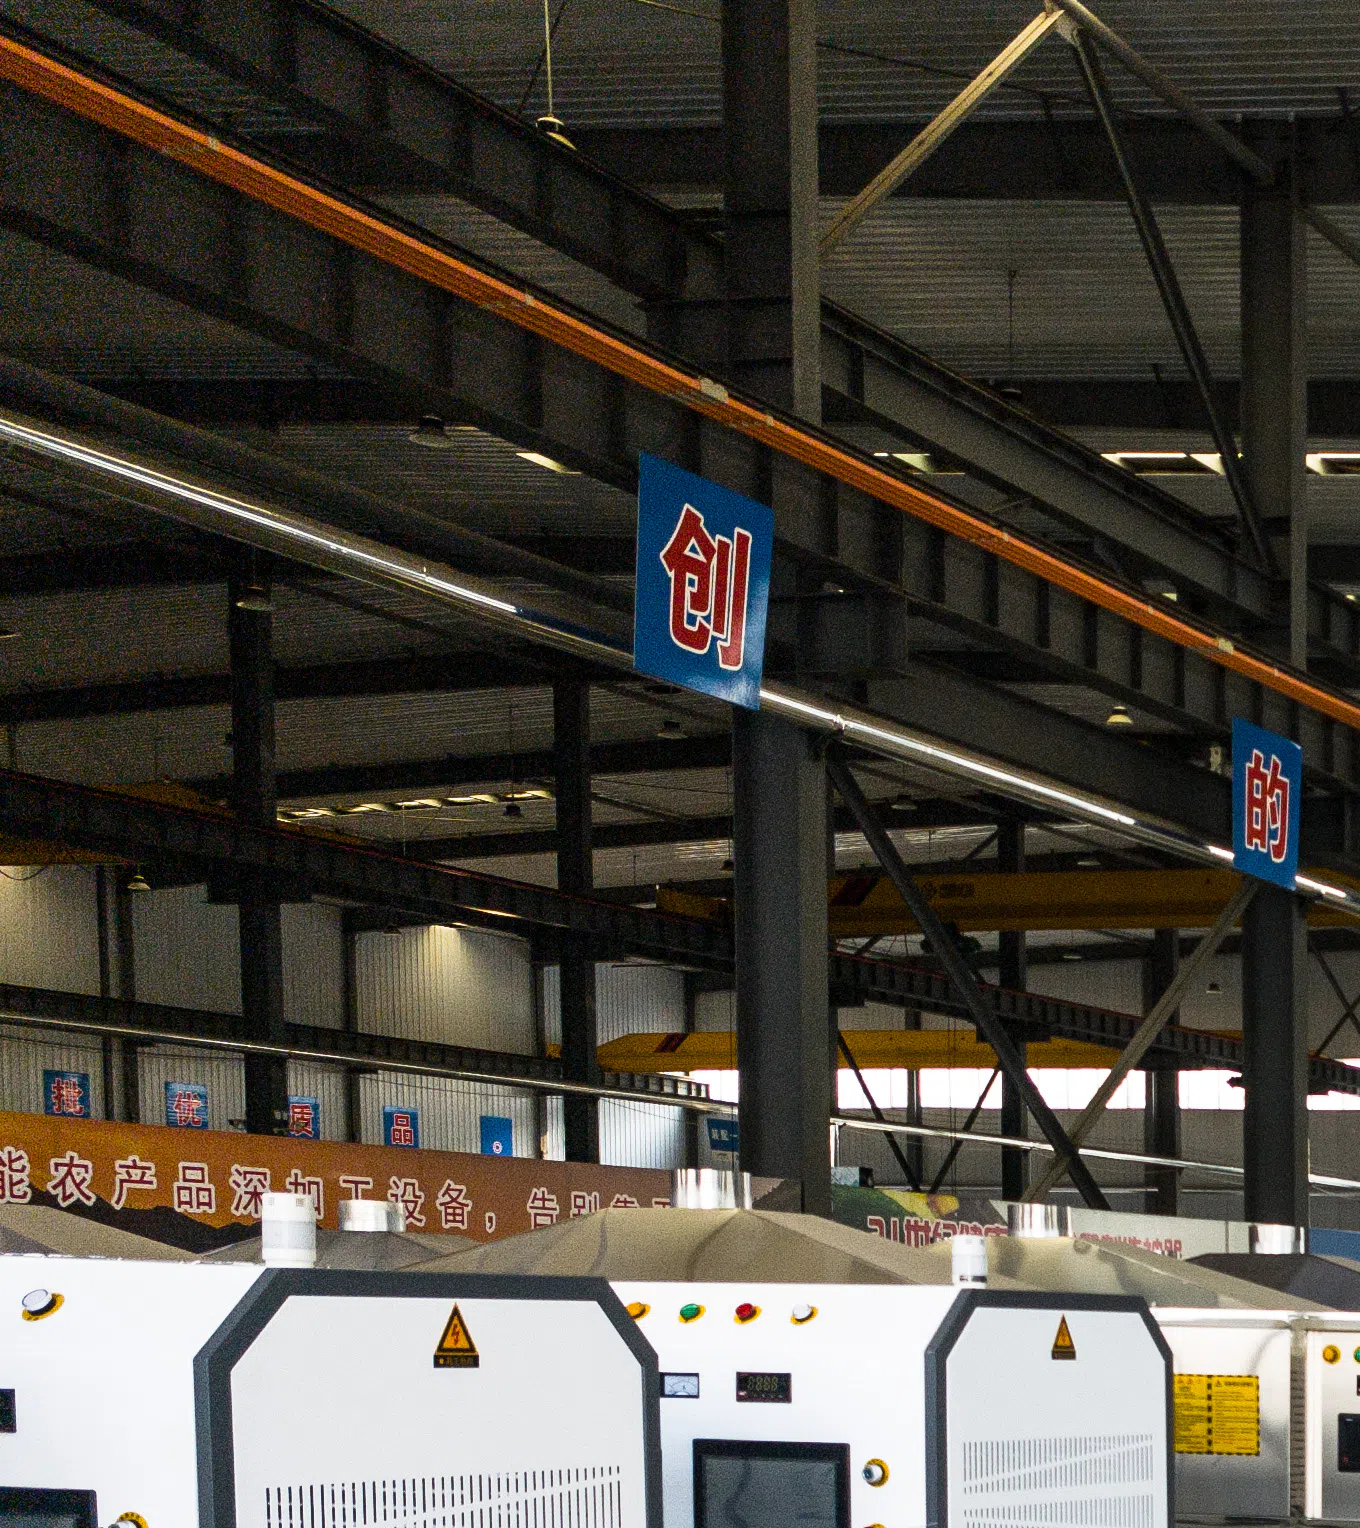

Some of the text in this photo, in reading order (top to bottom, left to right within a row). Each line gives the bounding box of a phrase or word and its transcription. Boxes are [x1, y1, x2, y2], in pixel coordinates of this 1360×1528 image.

[659, 502, 752, 671] 创
[1245, 748, 1290, 863] 的
[51, 1077, 414, 1147] 批 优 质 品
